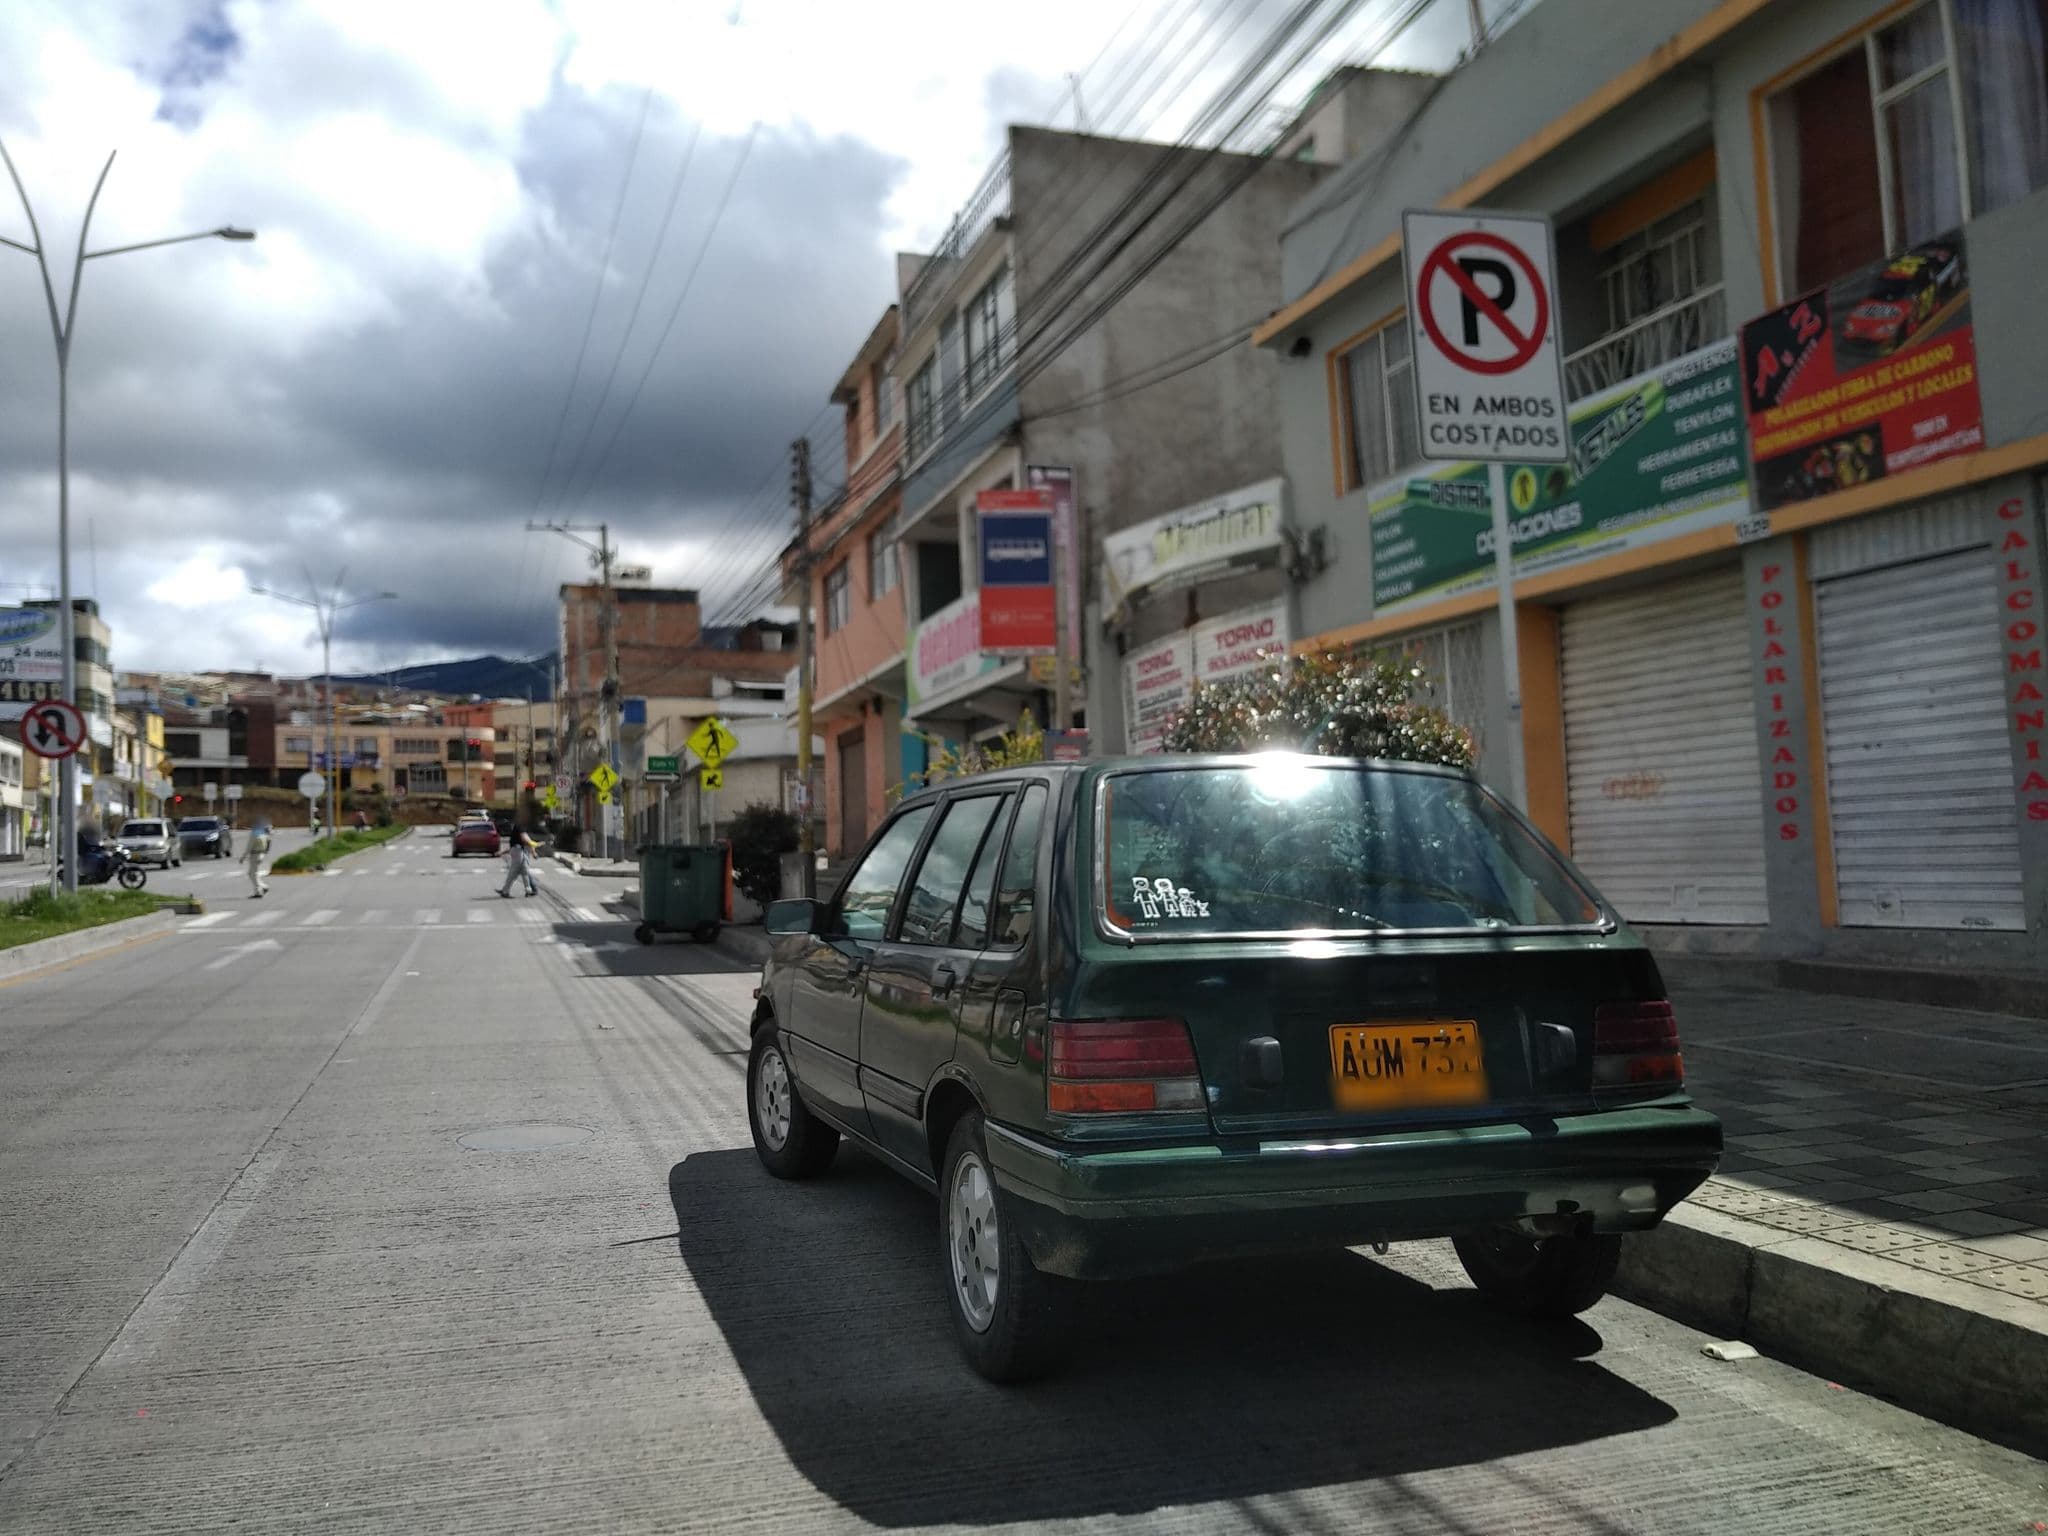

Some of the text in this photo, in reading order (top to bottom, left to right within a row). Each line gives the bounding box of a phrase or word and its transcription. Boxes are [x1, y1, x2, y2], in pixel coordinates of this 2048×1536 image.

[1458, 258, 1516, 346] P
[1894, 345, 1954, 380] CARBONO
[1916, 363, 1974, 398] LOCALES
[1428, 395, 1555, 418] EN AMBOS
[1665, 376, 1733, 413] DURAFLEX
[1429, 423, 1559, 448] COSTADOS
[1637, 428, 1738, 473] HERRAMIENTAS
[1660, 455, 1741, 493] FERRETERIA
[1476, 503, 1584, 555] DOACIONES
[1216, 617, 1275, 650] TORNO
[1136, 649, 1175, 676] TORNO
[1997, 498, 2048, 821] CALCOMANIAS
[1760, 565, 1798, 841] POLARIZADOS
